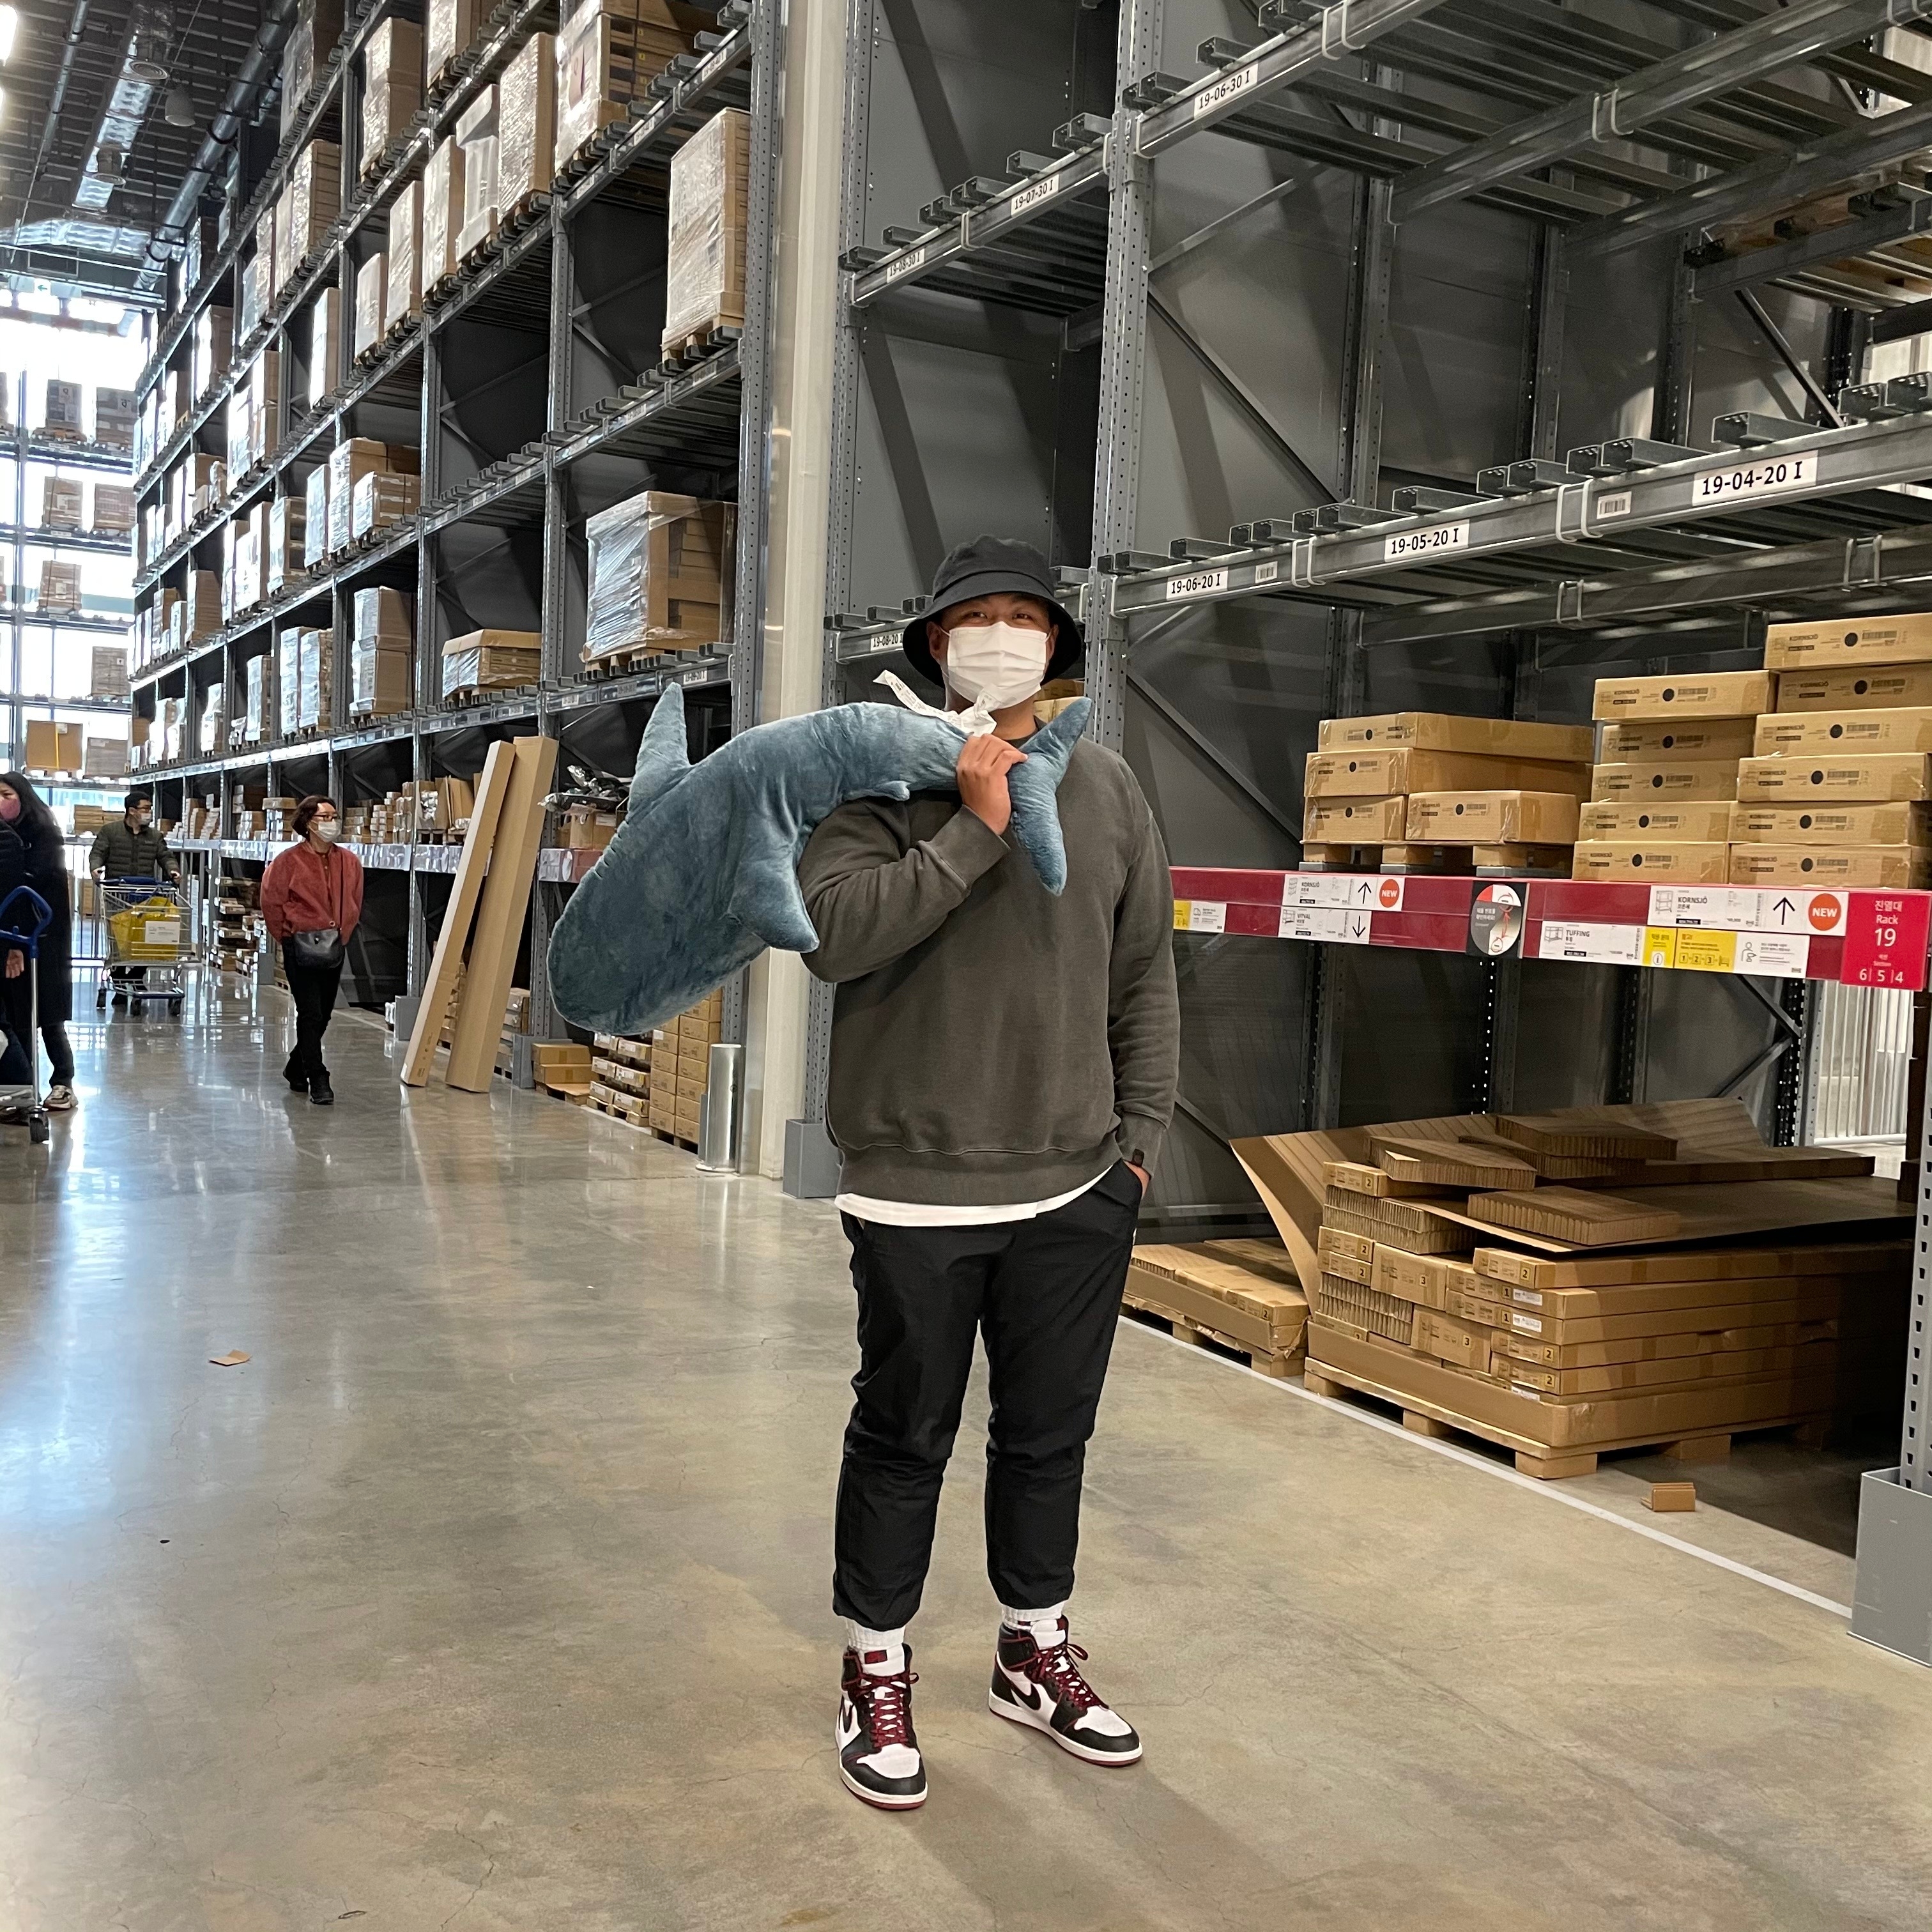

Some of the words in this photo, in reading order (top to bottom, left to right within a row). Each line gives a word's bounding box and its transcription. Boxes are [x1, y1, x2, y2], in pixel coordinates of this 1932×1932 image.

[1199, 75, 1242, 109] 19-06-30
[1015, 183, 1048, 210] 19-07-30
[1702, 464, 1786, 495] 19-04-20
[1391, 530, 1448, 554] 19-05-20
[1171, 574, 1213, 594] 19-06-20
[1381, 889, 1398, 898] NEW
[1678, 896, 1708, 904] KORNSJÖ
[1874, 900, 1903, 912] 진열대
[1812, 907, 1837, 917] NEW
[1876, 914, 1899, 924] Rack
[1874, 928, 1897, 947] 19
[1859, 968, 1867, 981] 6
[1877, 970, 1885, 982] 5
[1895, 971, 1903, 983] 4
[1522, 1269, 1528, 1278] 2
[1421, 1276, 1426, 1285] 3
[1505, 1288, 1509, 1296] 1
[1504, 1314, 1509, 1322] 1
[1464, 1337, 1469, 1346] 3
[1546, 1349, 1552, 1358] 2
[1547, 1376, 1552, 1384] 2
